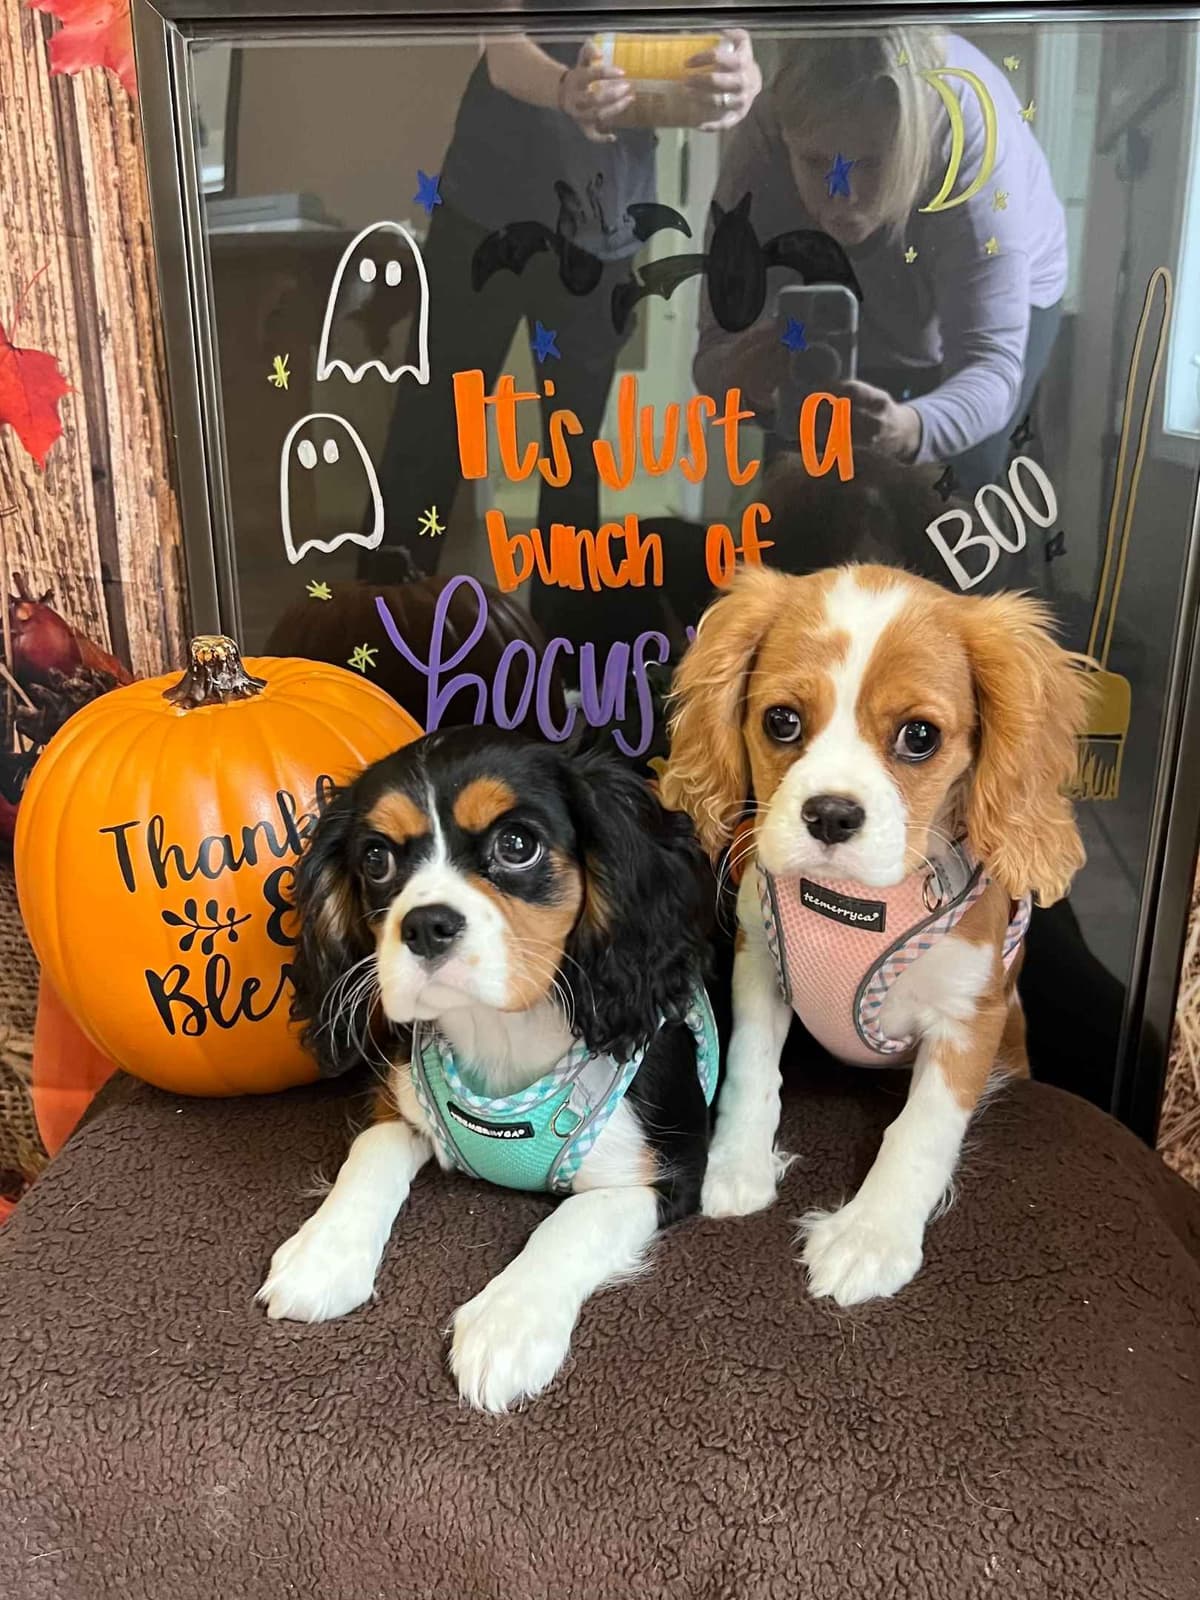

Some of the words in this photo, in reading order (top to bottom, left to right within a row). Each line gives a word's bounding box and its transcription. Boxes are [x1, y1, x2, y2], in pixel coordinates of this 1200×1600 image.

[453, 369, 583, 487] It's
[593, 374, 760, 491] Just
[800, 392, 855, 481] a
[485, 510, 664, 593] bunch
[705, 503, 775, 588] of
[925, 455, 1058, 591] BOO
[375, 575, 670, 757] hocus
